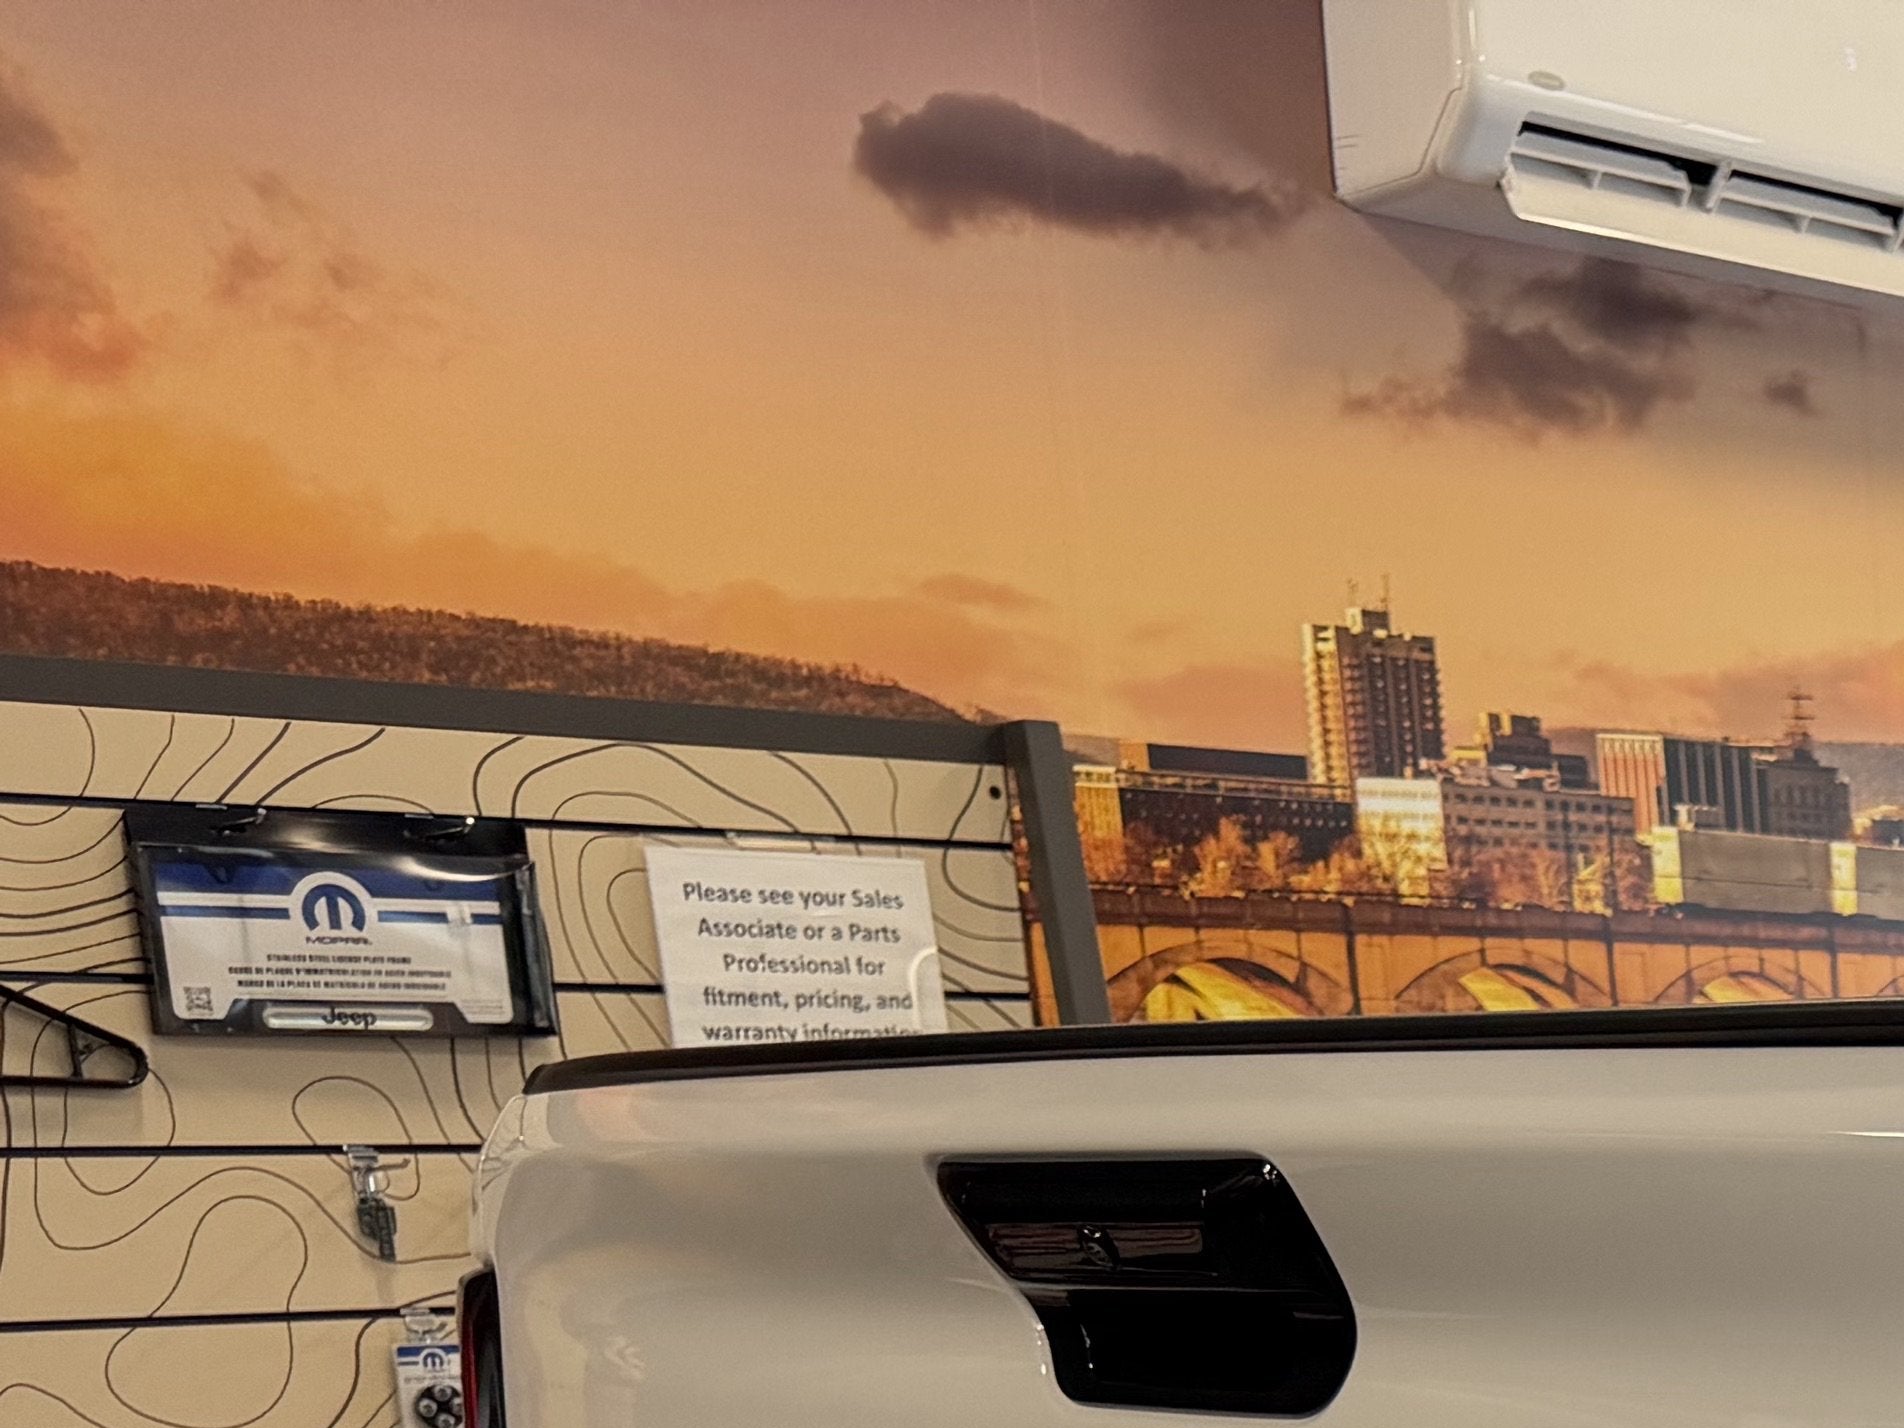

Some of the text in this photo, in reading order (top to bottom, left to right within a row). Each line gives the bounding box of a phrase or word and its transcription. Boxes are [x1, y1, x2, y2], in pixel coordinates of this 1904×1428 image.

[682, 882, 905, 910] Please see your Sales
[698, 918, 902, 943] Associate or a Parts
[723, 953, 886, 976] Professional for
[703, 987, 913, 1014] fitment, pricing, and
[321, 1006, 377, 1029] Jeep
[702, 1024, 798, 1041] warranty
